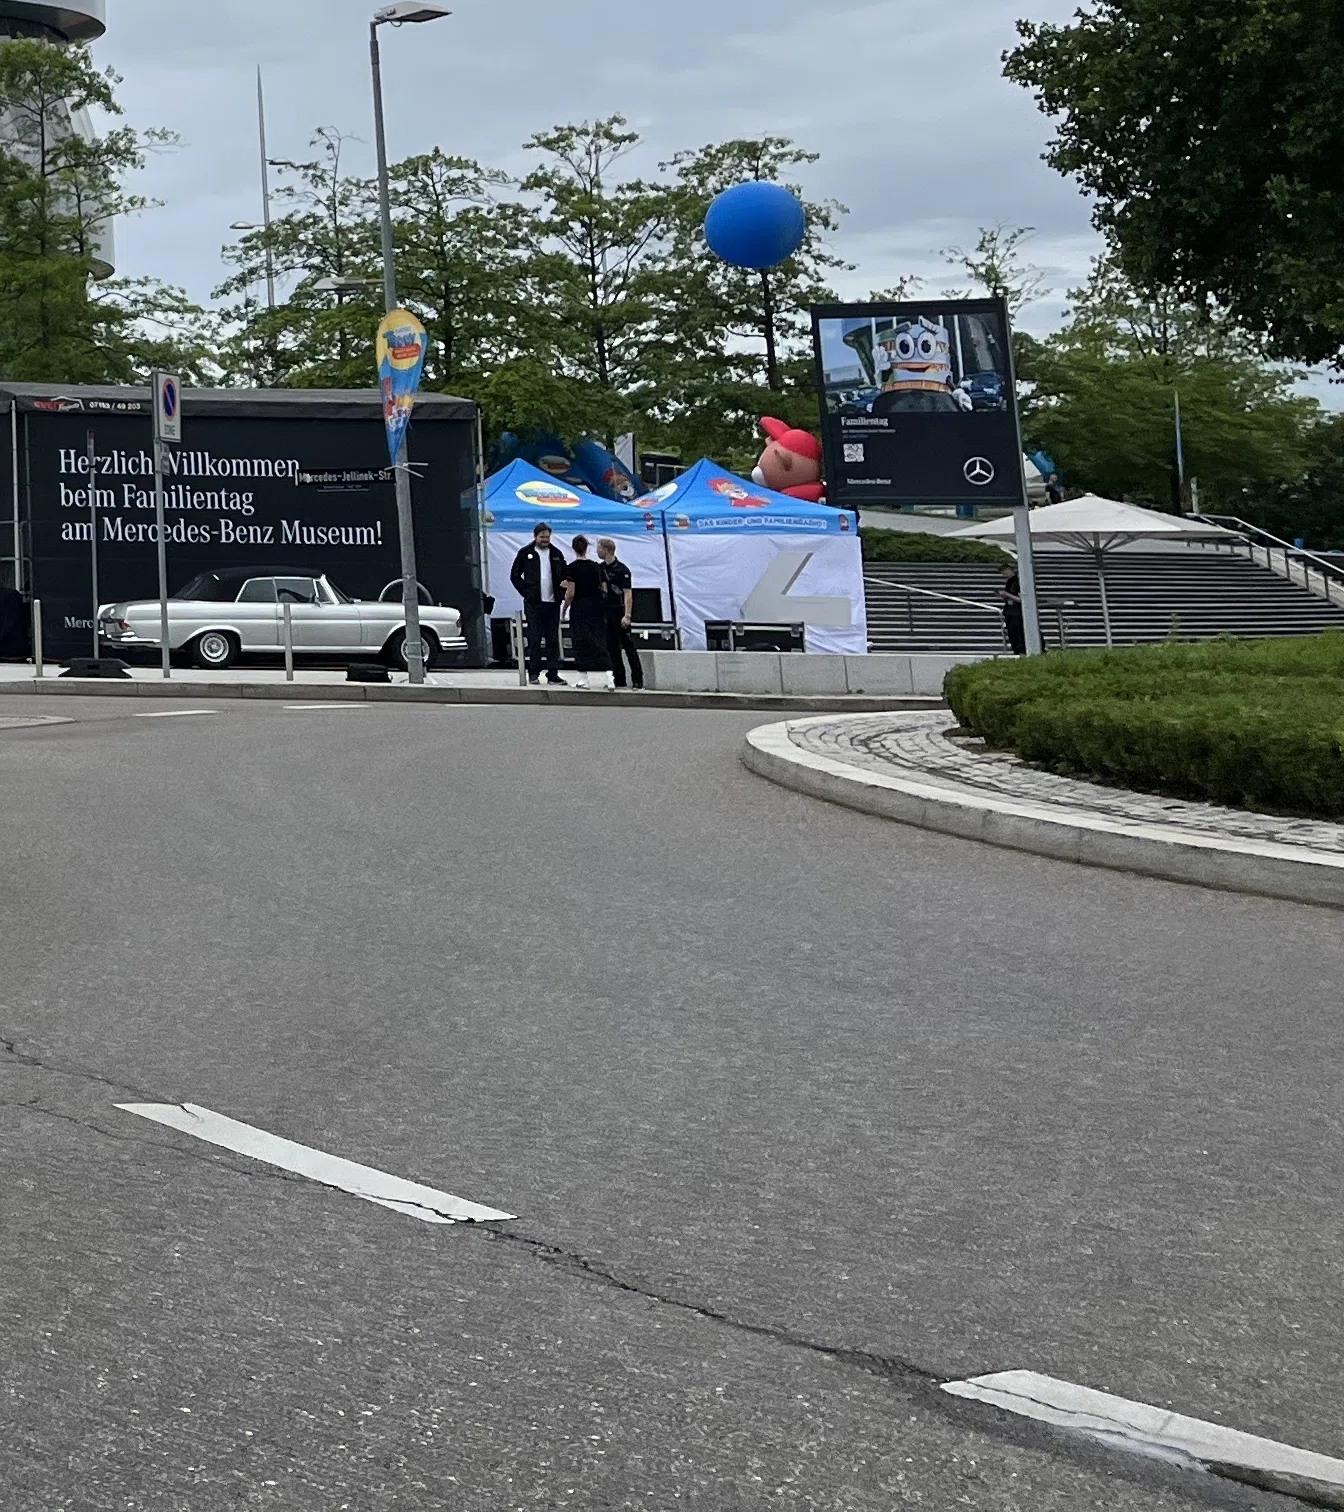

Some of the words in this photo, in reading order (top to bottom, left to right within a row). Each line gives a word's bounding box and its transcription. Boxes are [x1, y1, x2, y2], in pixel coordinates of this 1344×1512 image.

[59, 449, 154, 475] Herzlich
[60, 483, 116, 508] beim
[123, 483, 255, 516] Familientag
[62, 522, 96, 541] am
[102, 517, 274, 545] Mercedes-Benz
[281, 520, 383, 546] Museum!
